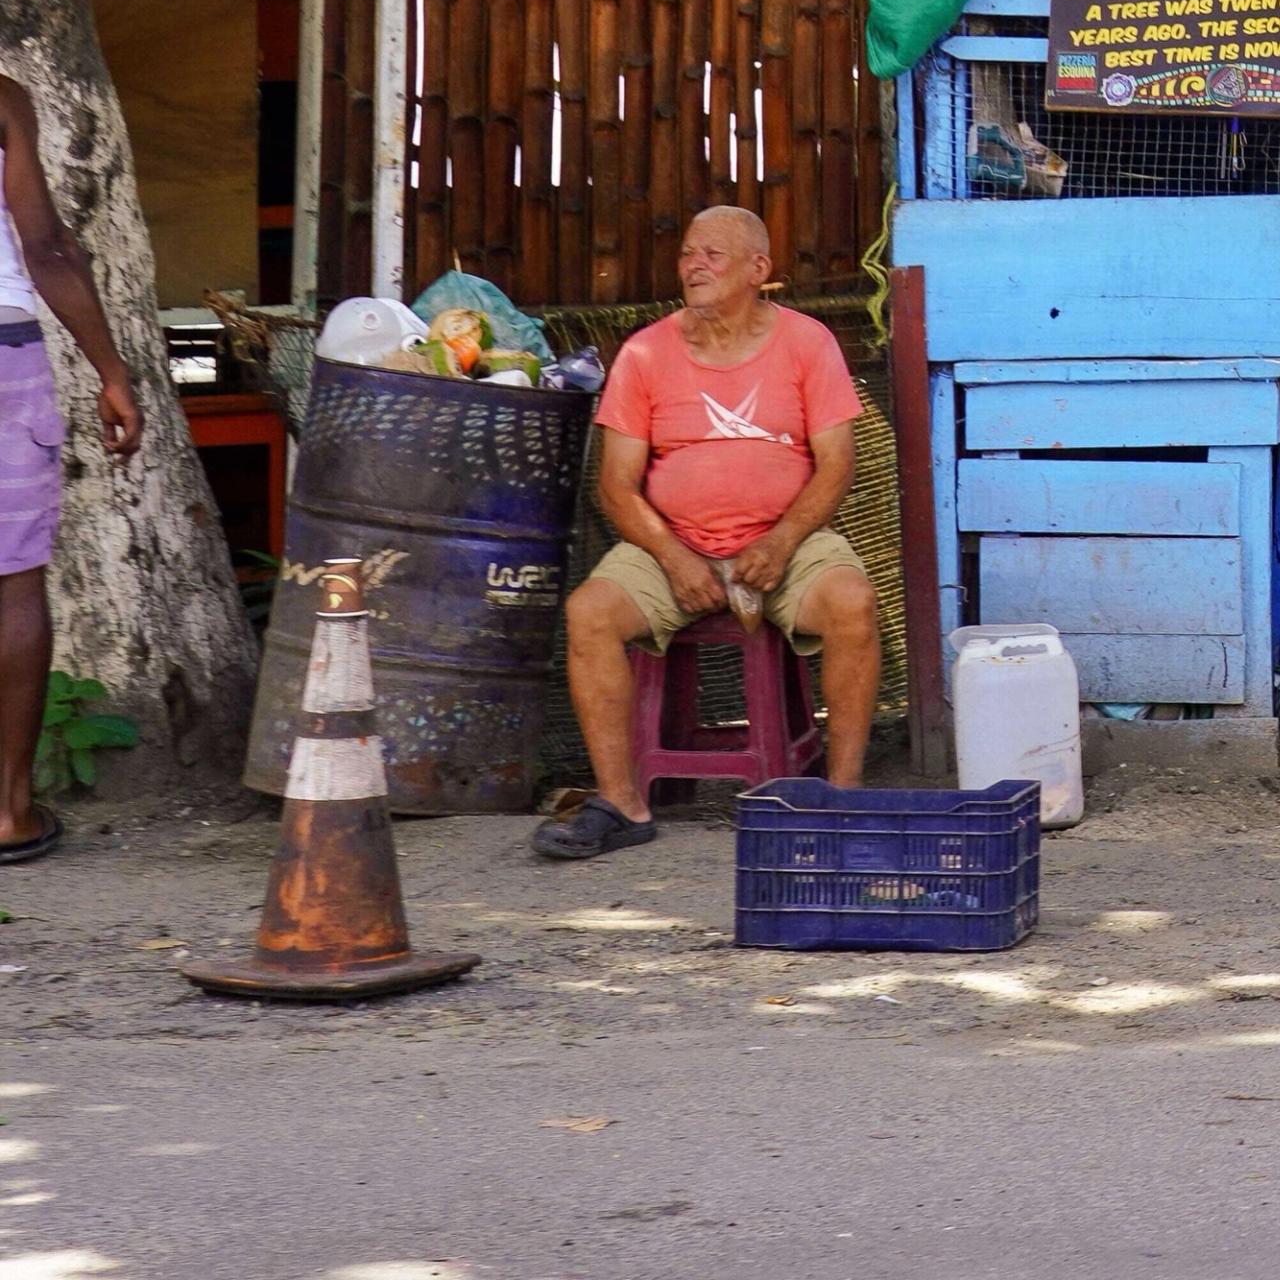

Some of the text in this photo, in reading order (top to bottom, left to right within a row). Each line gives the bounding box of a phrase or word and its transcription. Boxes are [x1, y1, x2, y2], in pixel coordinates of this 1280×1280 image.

[1086, 5, 1102, 22] A
[1107, 1, 1161, 21] TREE
[1069, 26, 1138, 47] YEARS
[1143, 24, 1192, 43] AGO.
[1198, 19, 1238, 38] THE
[1104, 48, 1158, 68] BEST
[1162, 43, 1214, 63] TIME
[1219, 42, 1240, 60] IS
